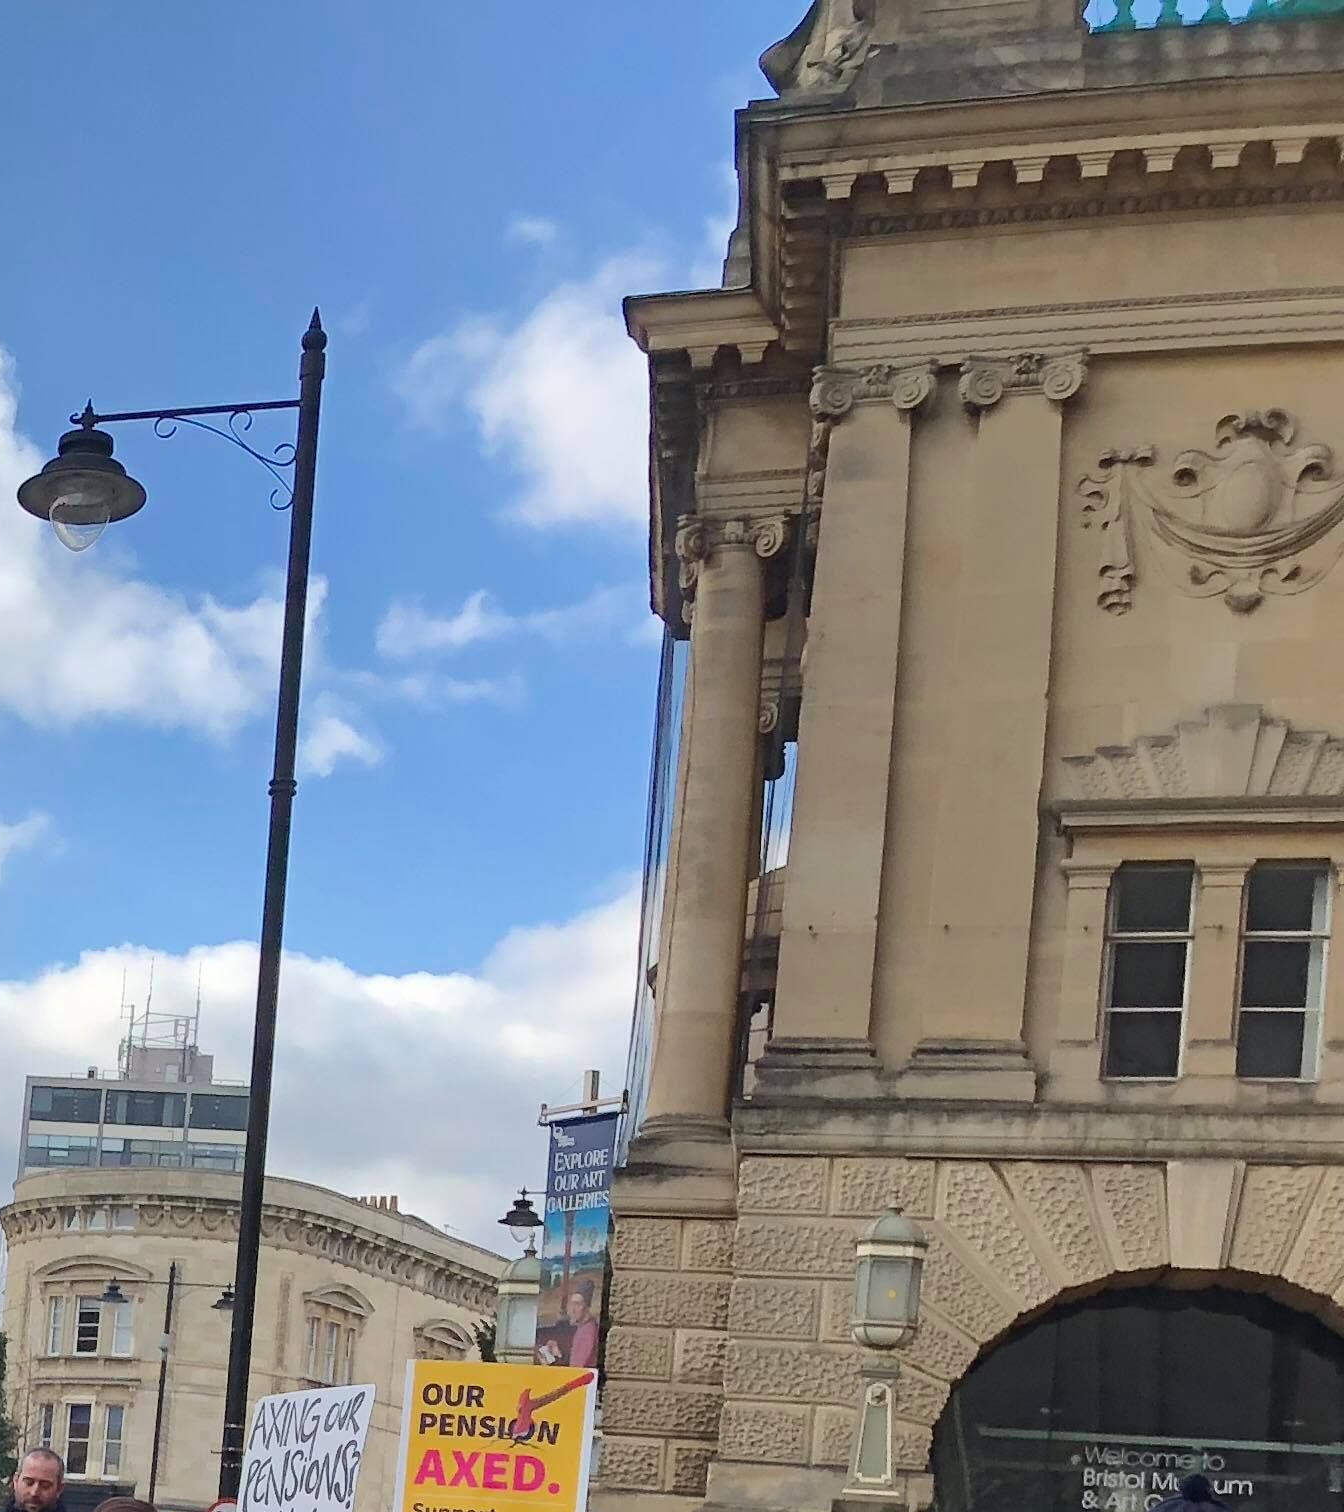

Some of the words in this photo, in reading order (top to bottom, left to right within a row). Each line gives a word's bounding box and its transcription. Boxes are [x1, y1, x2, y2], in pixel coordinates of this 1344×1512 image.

[554, 1149, 609, 1172] EXPLORE
[554, 1173, 579, 1192] OUR
[581, 1169, 606, 1189] ART
[422, 1383, 485, 1408] OUR
[249, 1397, 322, 1460] AXING
[324, 1391, 365, 1434] OUR
[419, 1413, 560, 1445] PENSION
[1084, 1445, 1196, 1469] Welcome
[1201, 1452, 1225, 1471] to
[414, 1449, 560, 1495] AXED.
[1083, 1468, 1145, 1489] Bristol
[1152, 1472, 1253, 1496] Muum
[1082, 1490, 1098, 1510] &
[1105, 1493, 1137, 1511] Art
